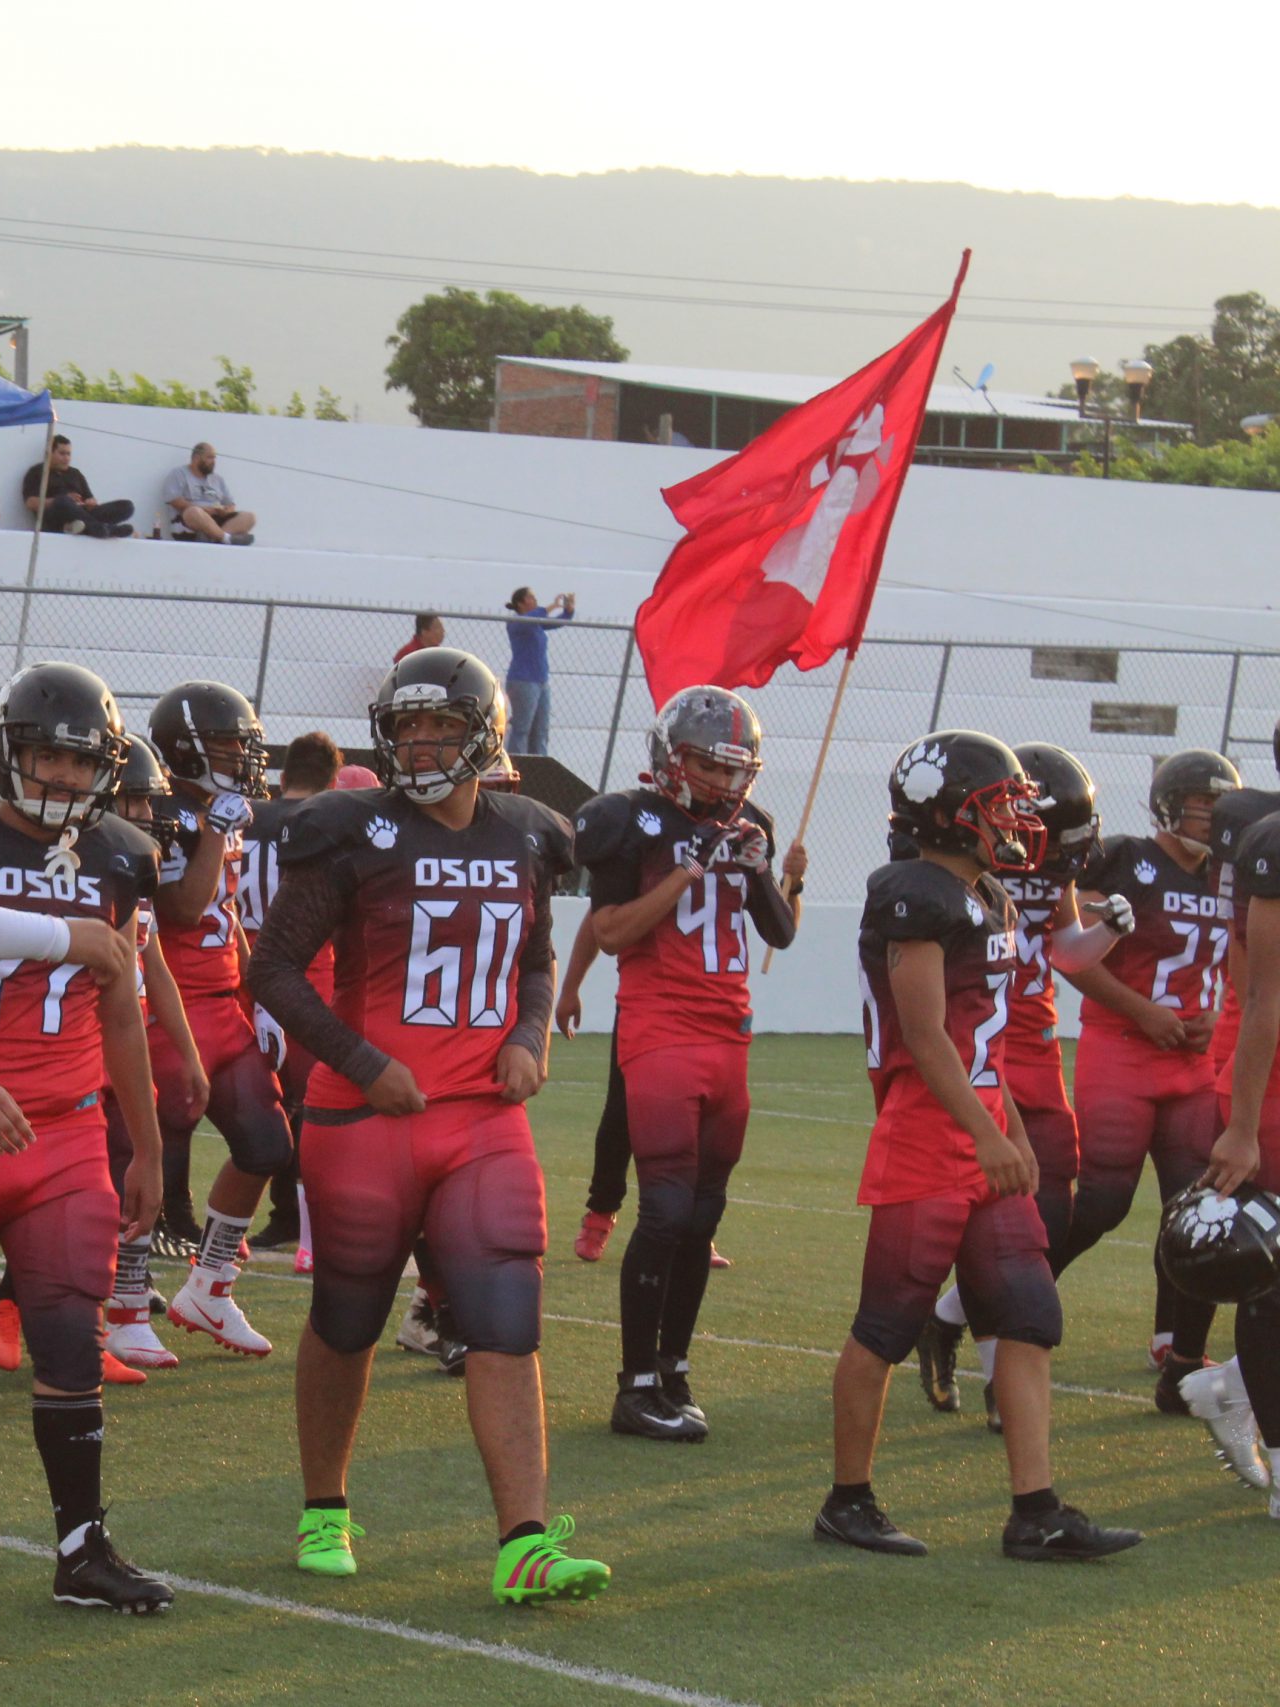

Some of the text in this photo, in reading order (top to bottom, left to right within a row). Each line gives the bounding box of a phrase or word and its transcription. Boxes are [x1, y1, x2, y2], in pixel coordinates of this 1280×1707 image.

[414, 857, 519, 889] OSOS
[1162, 891, 1220, 918] OSO
[401, 899, 524, 1028] 60
